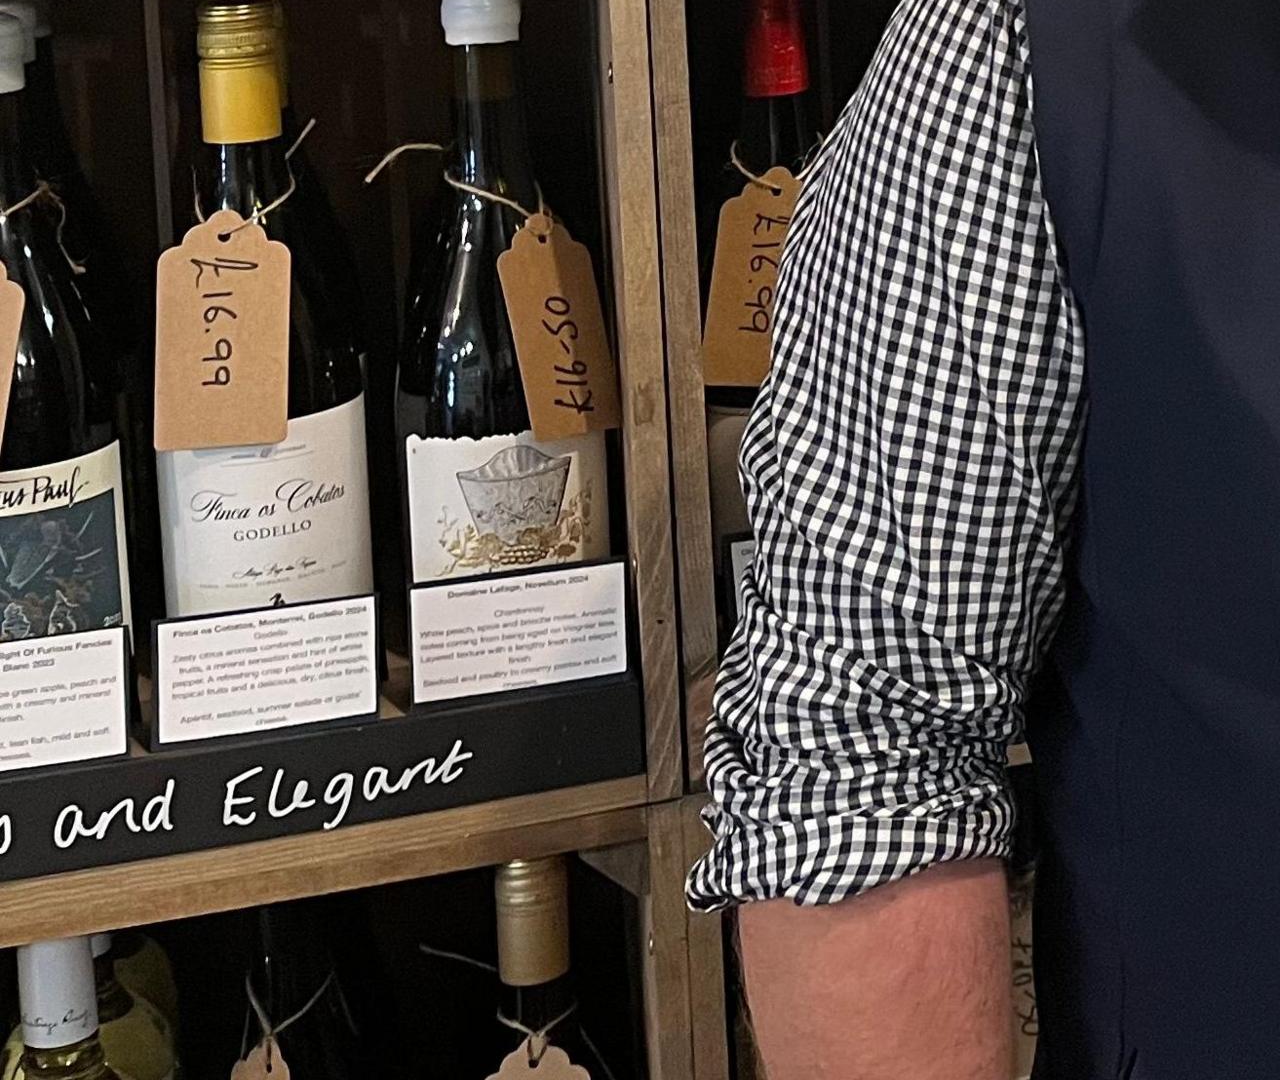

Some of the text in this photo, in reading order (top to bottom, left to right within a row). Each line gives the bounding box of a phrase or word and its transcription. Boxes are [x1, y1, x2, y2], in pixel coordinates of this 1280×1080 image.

[190, 256, 259, 388] £16.99
[191, 490, 252, 523] Finca
[233, 519, 313, 542] GODELLO
[54, 739, 473, 848] and Elegant
